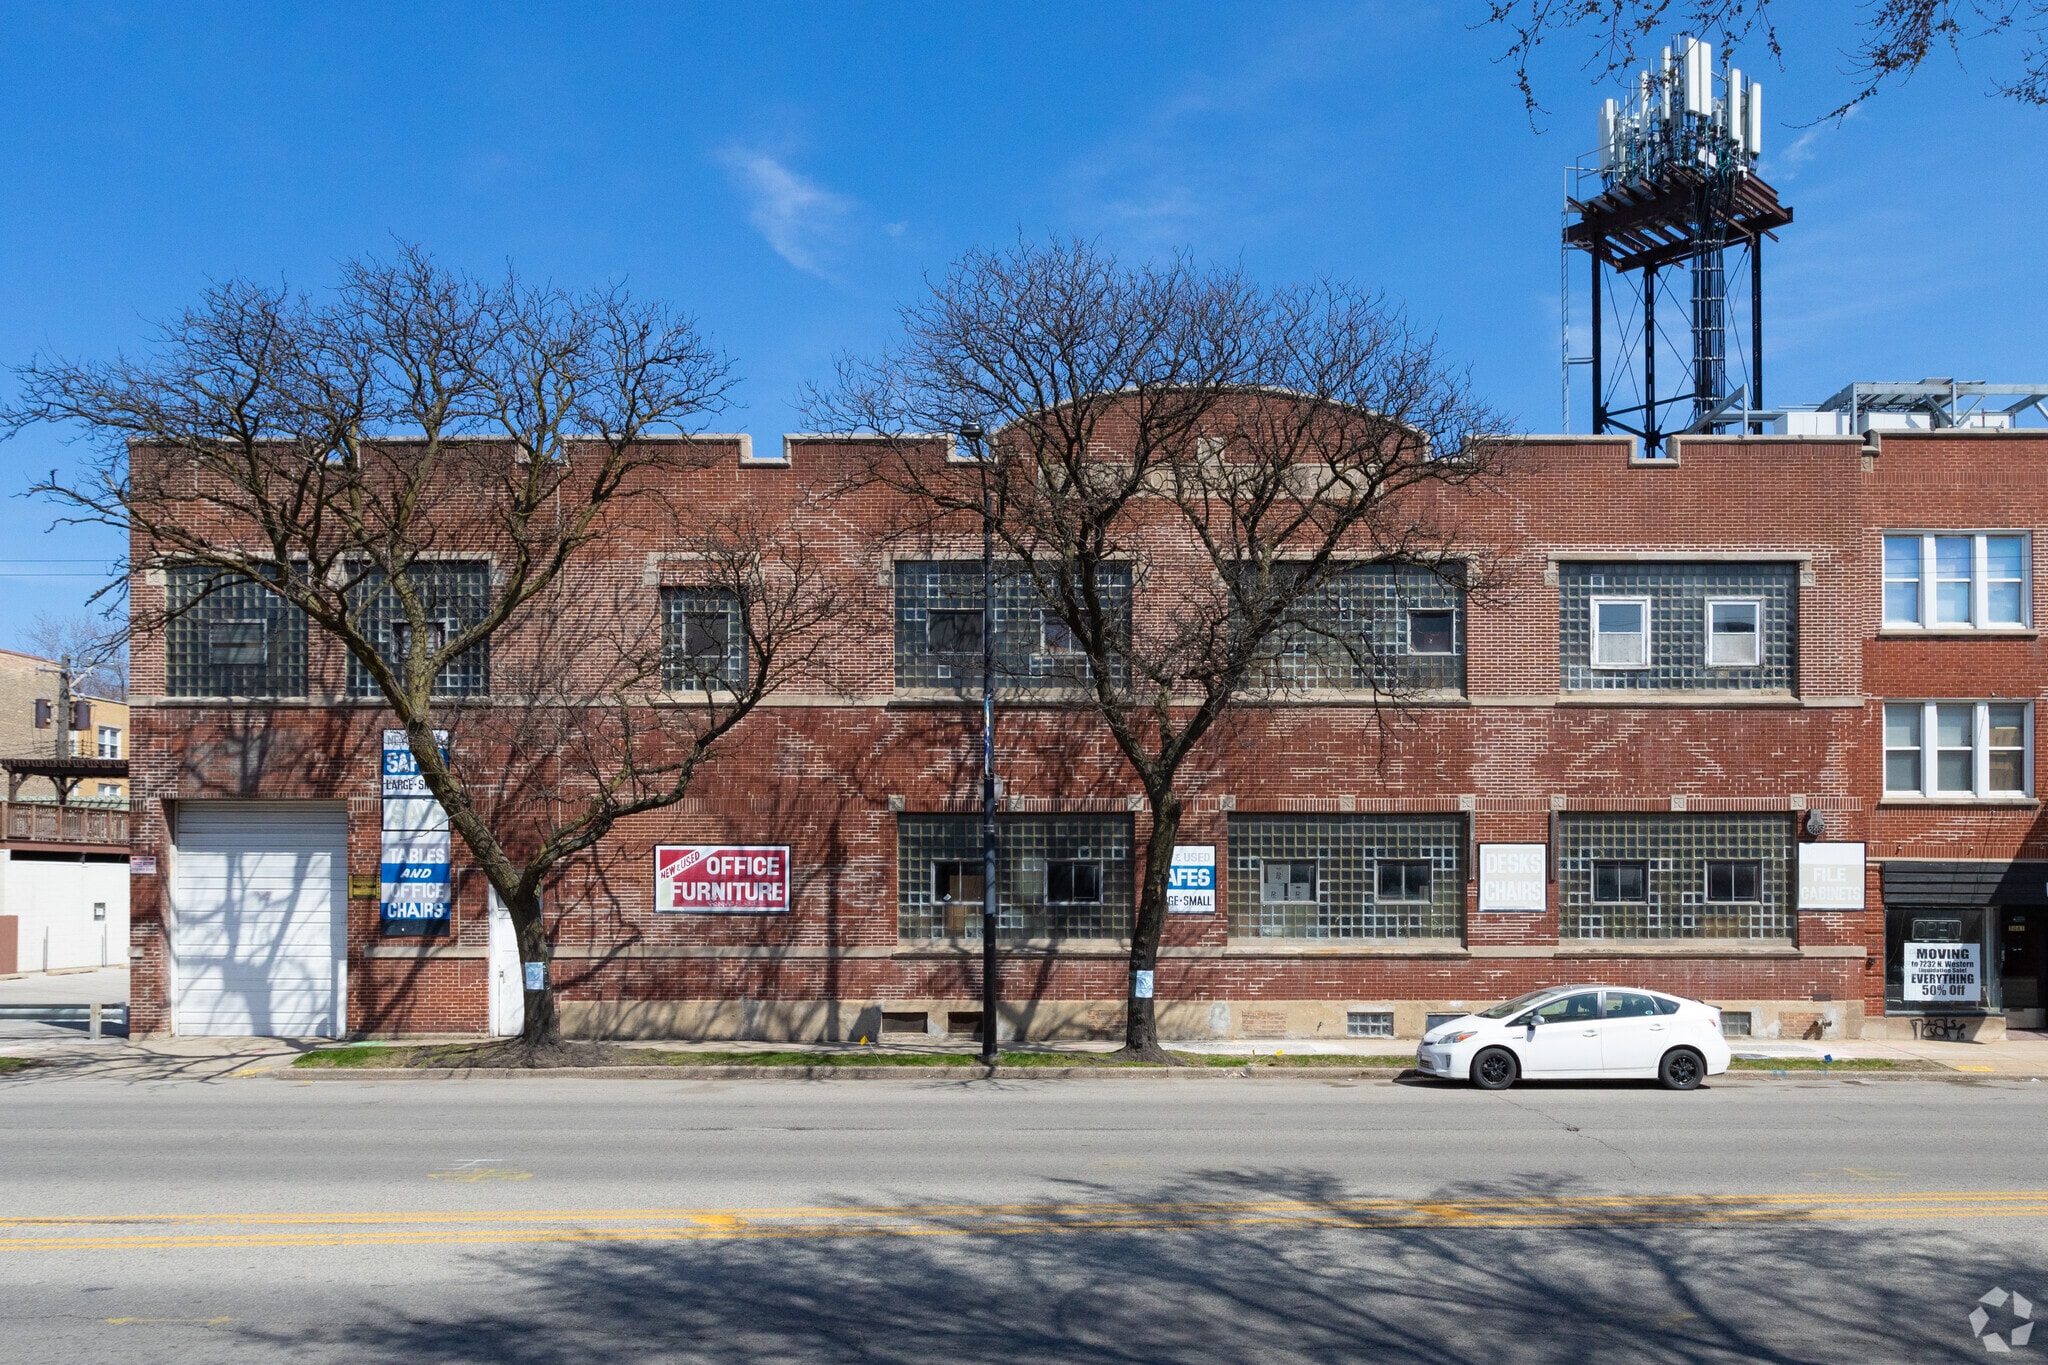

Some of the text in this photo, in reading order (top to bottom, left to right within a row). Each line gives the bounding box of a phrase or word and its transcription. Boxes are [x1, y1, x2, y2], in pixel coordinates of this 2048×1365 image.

[386, 779, 413, 790] LARGE
[388, 847, 446, 864] TABLES
[1184, 852, 1210, 862] USED
[1486, 853, 1541, 873] DESKS
[660, 864, 676, 879] NEW
[680, 851, 700, 869] USED
[706, 856, 779, 876] OFFICE
[400, 868, 432, 879] AND
[1168, 868, 1211, 887] AFES
[1813, 867, 1847, 882] FILE
[390, 883, 444, 898] OFFICE
[672, 881, 783, 901] FURNITURE
[1485, 880, 1541, 901] CHAIRS
[1801, 886, 1861, 901] CABINETS
[1183, 895, 1212, 906] SMALL
[387, 902, 444, 918] CHAIRS
[1916, 948, 1970, 959] MOVING
[1911, 973, 1975, 984] EVERYTHING
[1922, 985, 1965, 996] 50% Off
